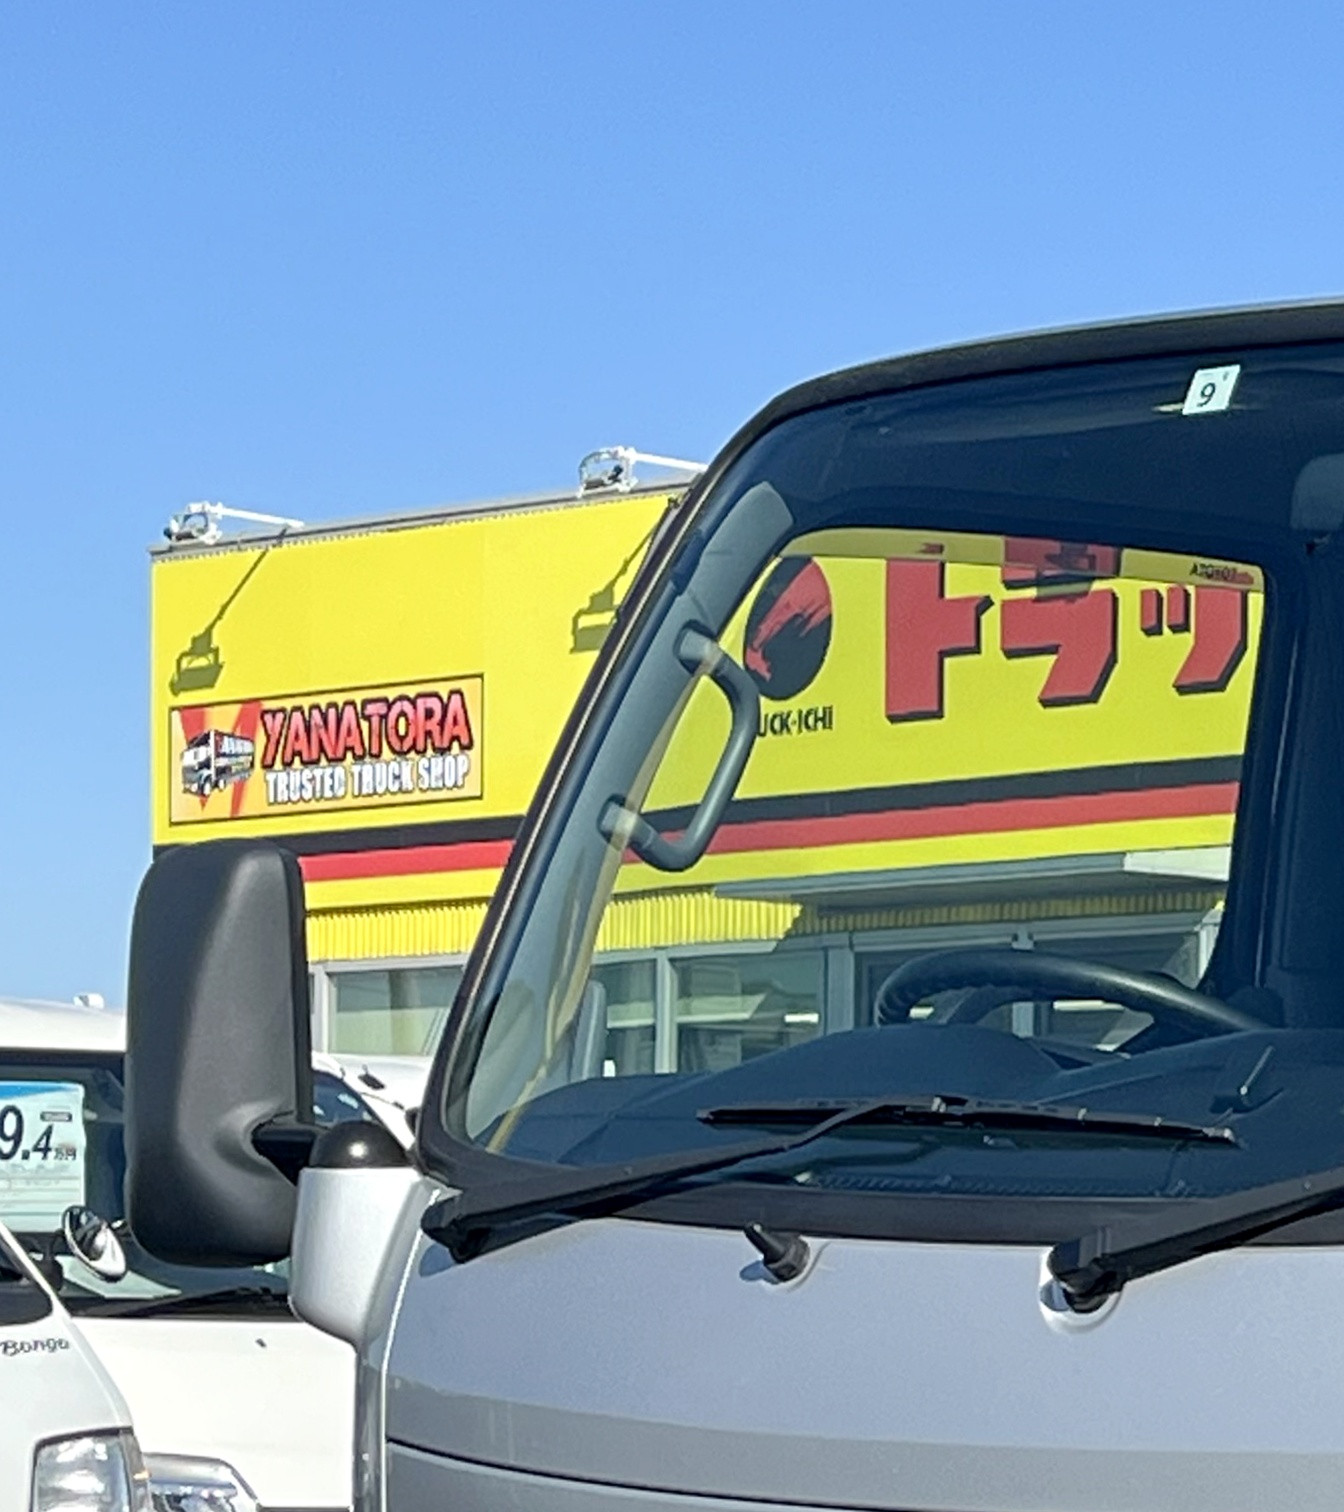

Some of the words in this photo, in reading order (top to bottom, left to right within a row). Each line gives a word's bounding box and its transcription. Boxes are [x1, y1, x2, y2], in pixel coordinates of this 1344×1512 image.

[1197, 382, 1216, 407] 9
[261, 688, 474, 769] YANATORA
[265, 766, 346, 806] TRUSTED
[351, 758, 413, 798] TRUCK
[418, 753, 471, 791] SHOP
